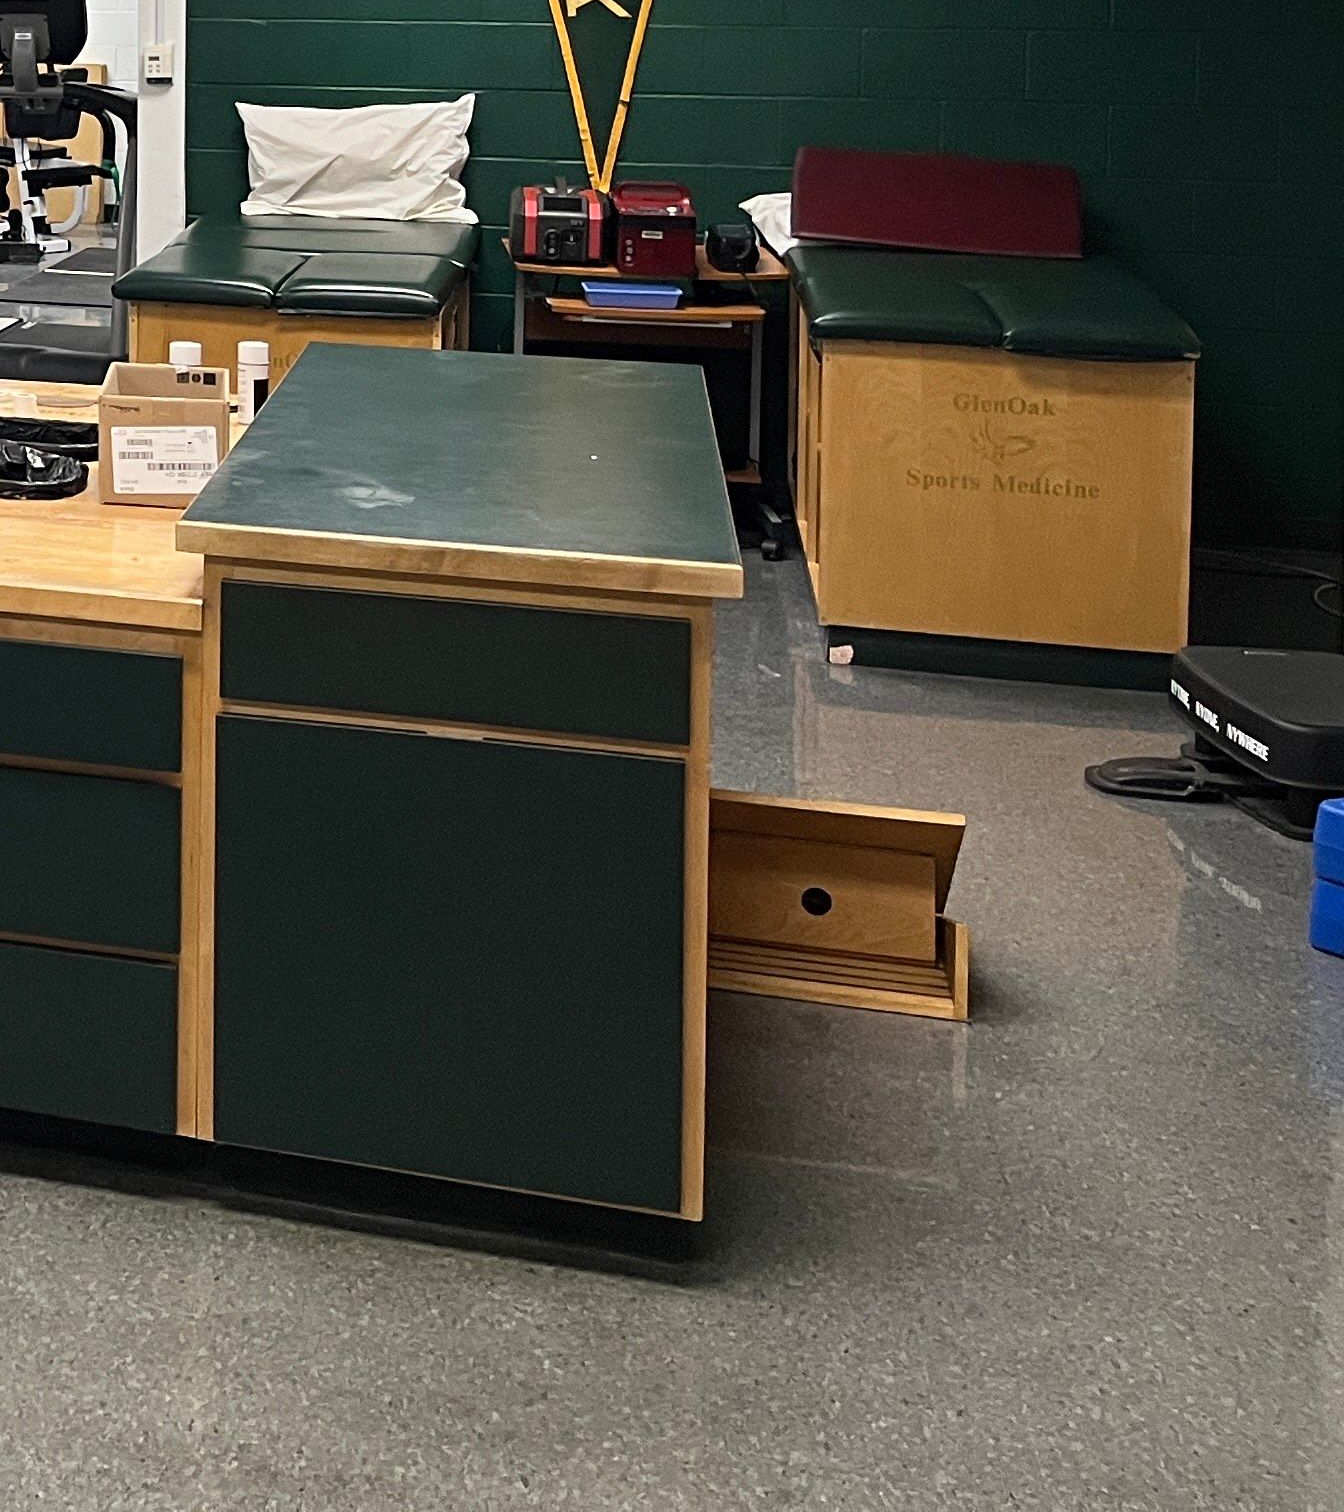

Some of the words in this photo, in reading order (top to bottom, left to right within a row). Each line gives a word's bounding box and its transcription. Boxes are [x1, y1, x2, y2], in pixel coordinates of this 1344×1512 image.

[952, 392, 1056, 417] GlenOak
[905, 468, 981, 491] Sports
[992, 474, 1101, 499] Medicine
